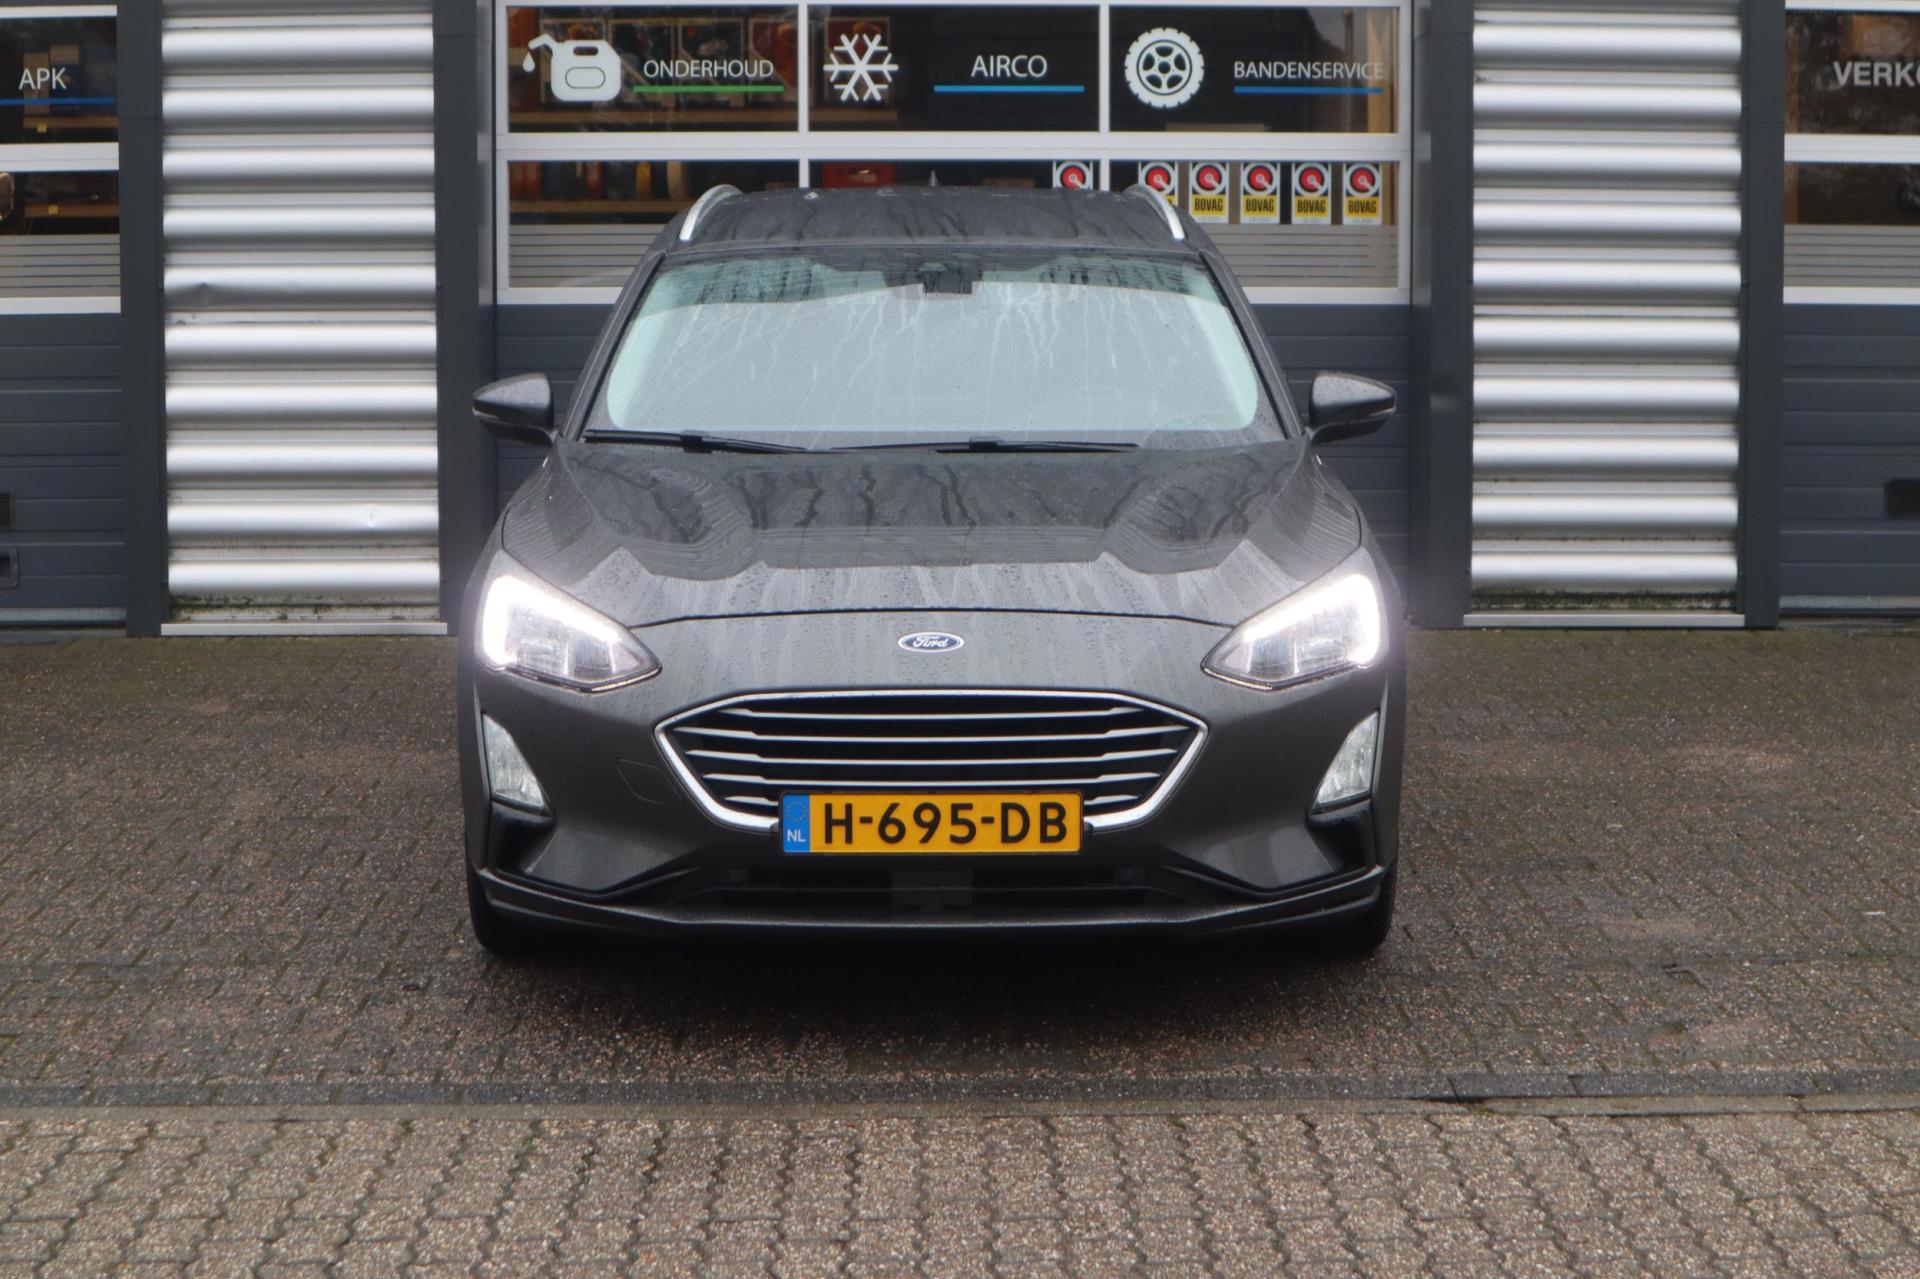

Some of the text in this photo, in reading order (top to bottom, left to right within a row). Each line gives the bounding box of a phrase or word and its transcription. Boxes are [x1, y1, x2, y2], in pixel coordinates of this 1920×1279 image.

[643, 59, 774, 78] ONDERHOUD
[971, 54, 1048, 79] AIRCO
[1233, 61, 1385, 80] BANDENSERVICE
[1833, 61, 1920, 87] VERK
[18, 67, 68, 90] APK
[1194, 197, 1224, 212] BOVAG
[1245, 198, 1275, 213] BOVAG
[1297, 199, 1326, 213] BOVAG
[1348, 199, 1377, 213] BOVAG
[912, 635, 950, 648] Ford
[823, 802, 1068, 844] H-695-DB
[786, 828, 806, 843] NL
